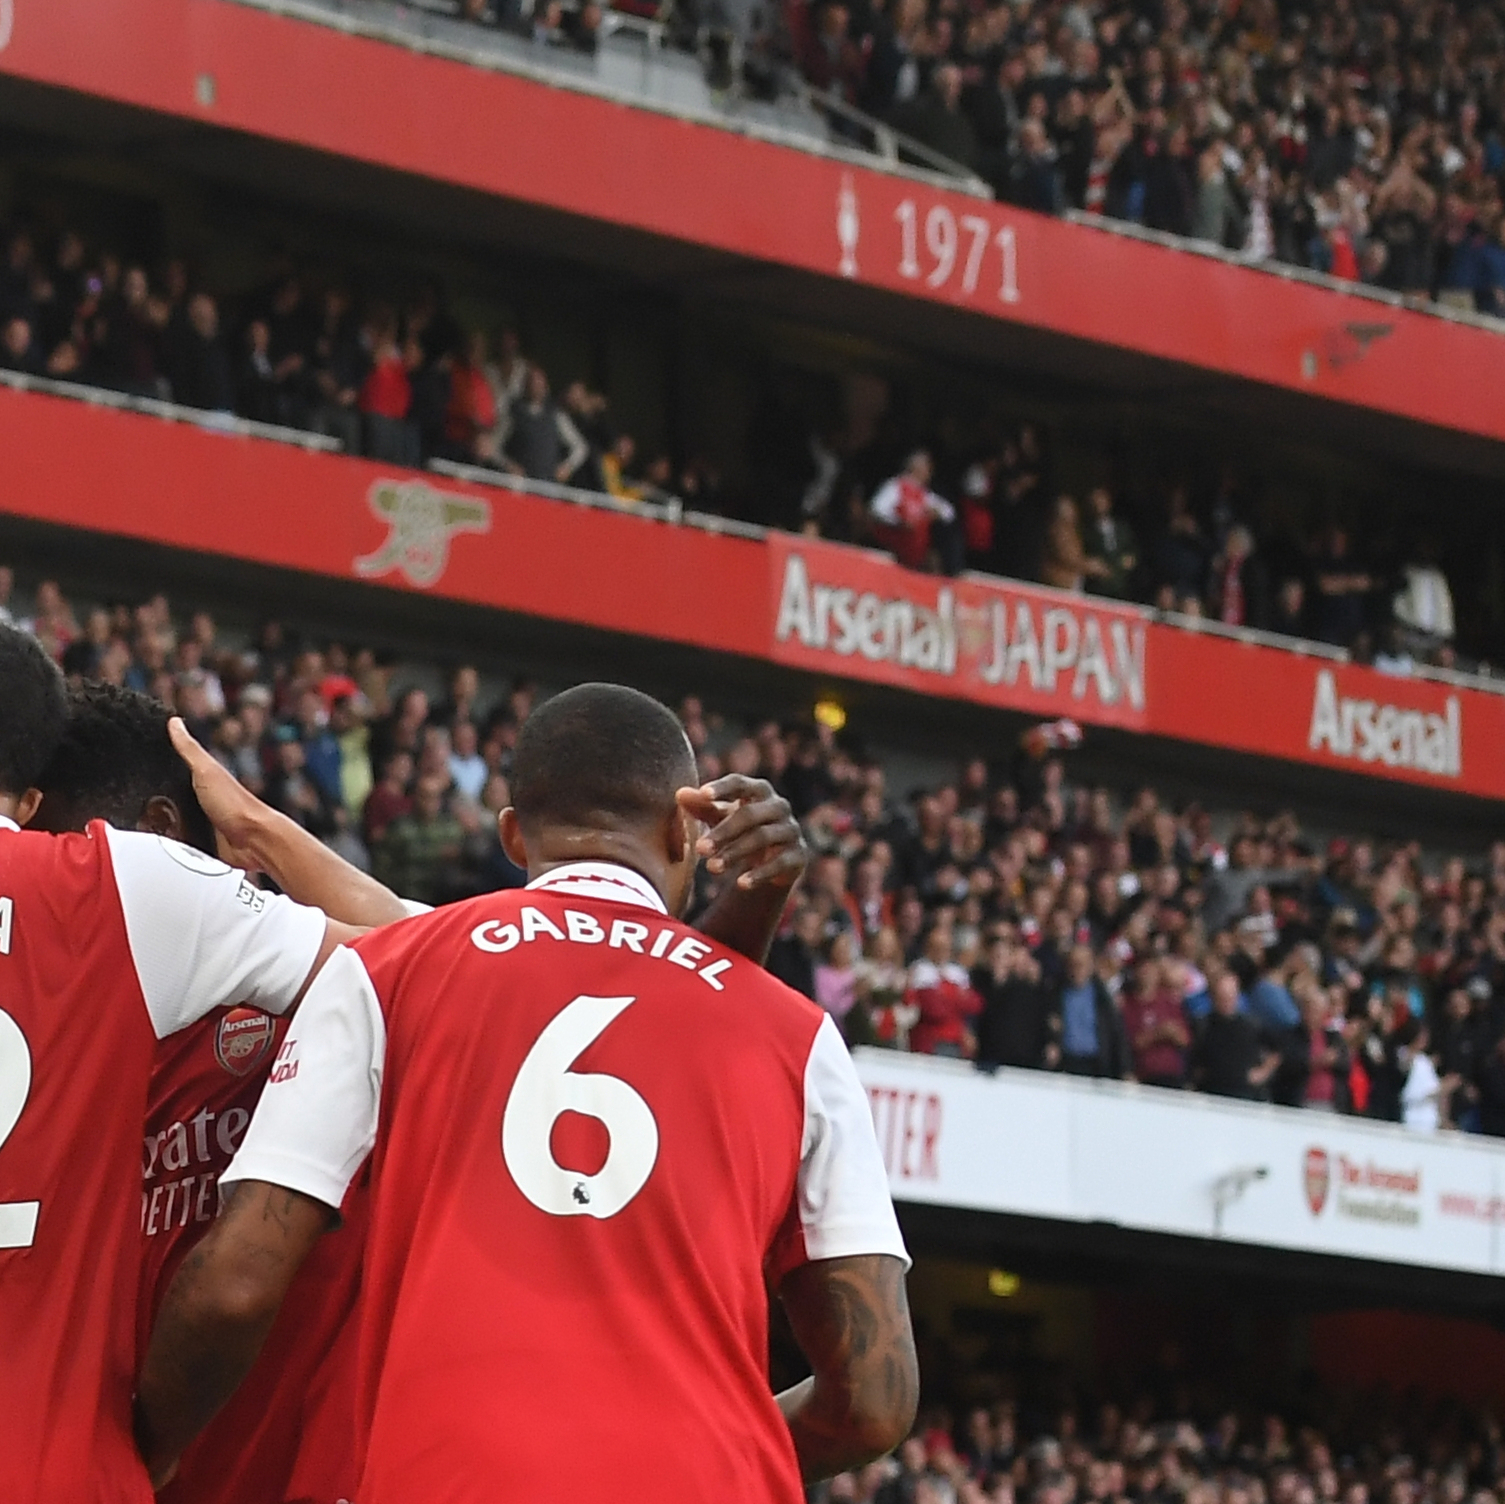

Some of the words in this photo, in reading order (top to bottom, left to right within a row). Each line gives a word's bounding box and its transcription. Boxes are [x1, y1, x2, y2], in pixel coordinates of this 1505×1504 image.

[894, 199, 1021, 305] 1971
[774, 552, 956, 677] Arsenal
[979, 597, 1148, 713] JAPAN
[1309, 668, 1463, 779] Arsenal
[470, 906, 733, 992] GABRIEL
[223, 1015, 266, 1034] Arsenal
[143, 1105, 250, 1180] rate
[502, 994, 659, 1220] 6
[865, 1085, 943, 1182] TTER
